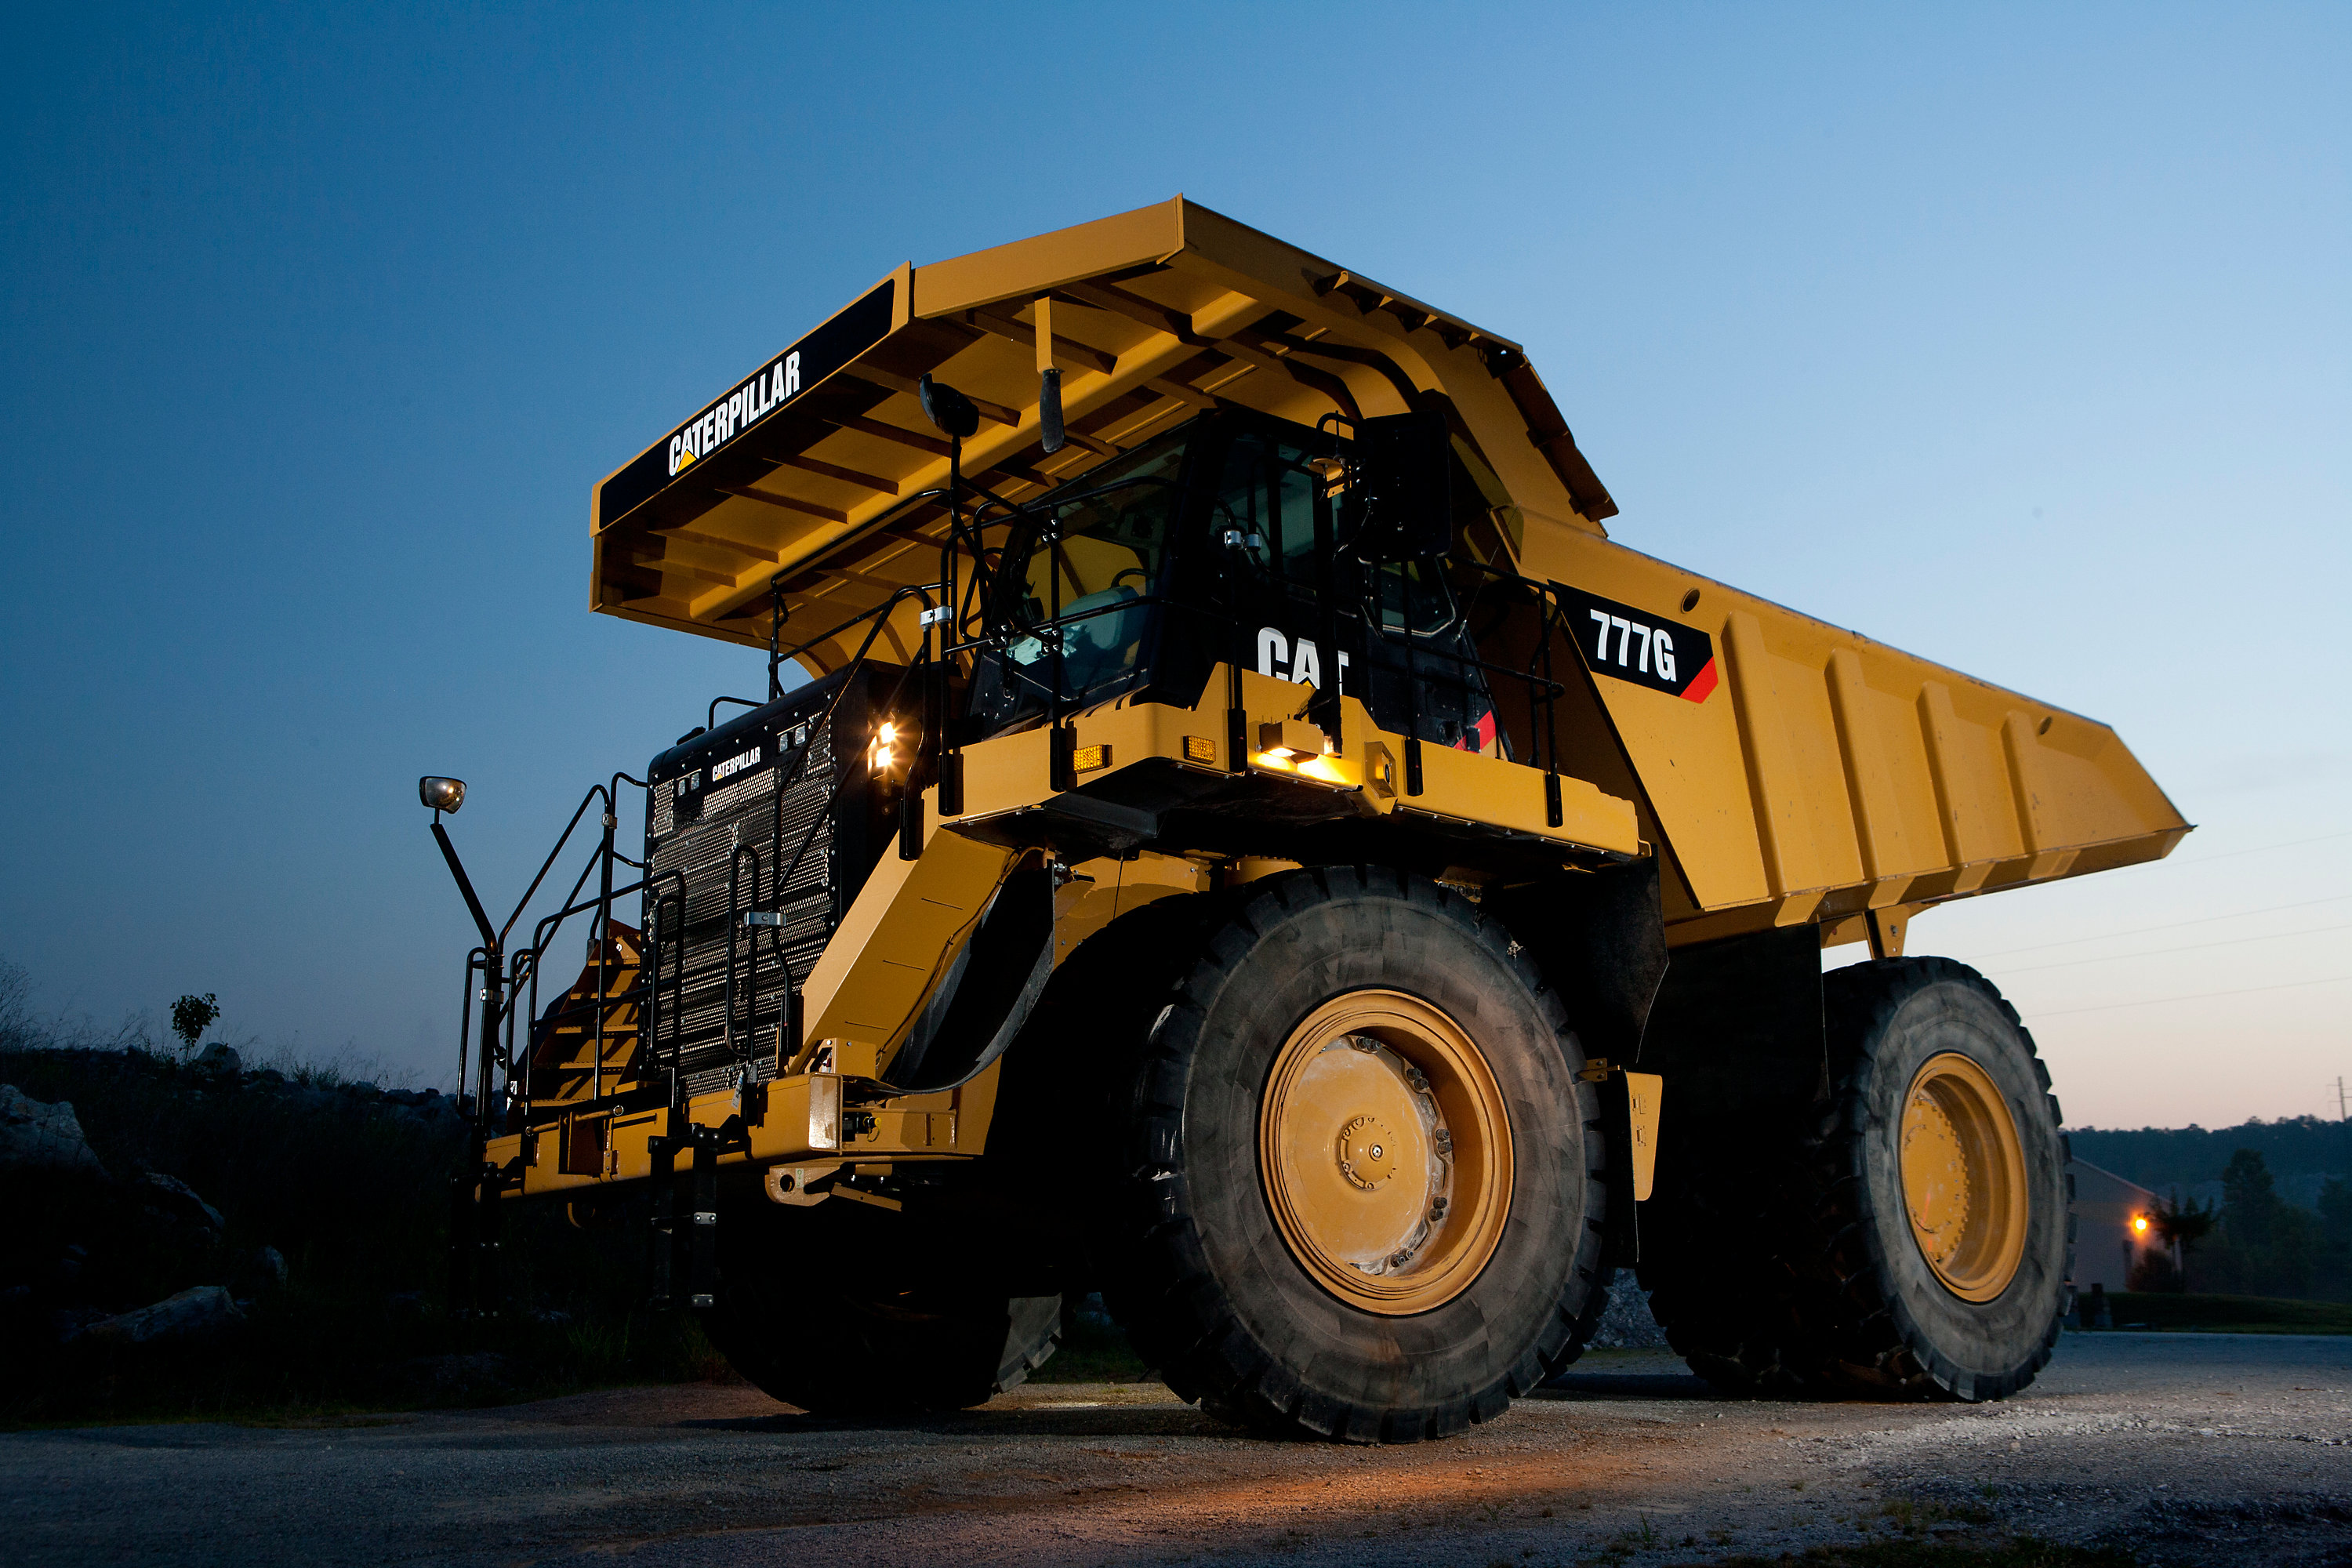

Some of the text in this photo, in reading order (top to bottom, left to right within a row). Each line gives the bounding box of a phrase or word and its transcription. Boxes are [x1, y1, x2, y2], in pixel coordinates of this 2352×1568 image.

[669, 350, 800, 477] CATERPILLAR
[1590, 608, 1677, 682] 777G
[712, 746, 760, 782] CATERPILLAR
